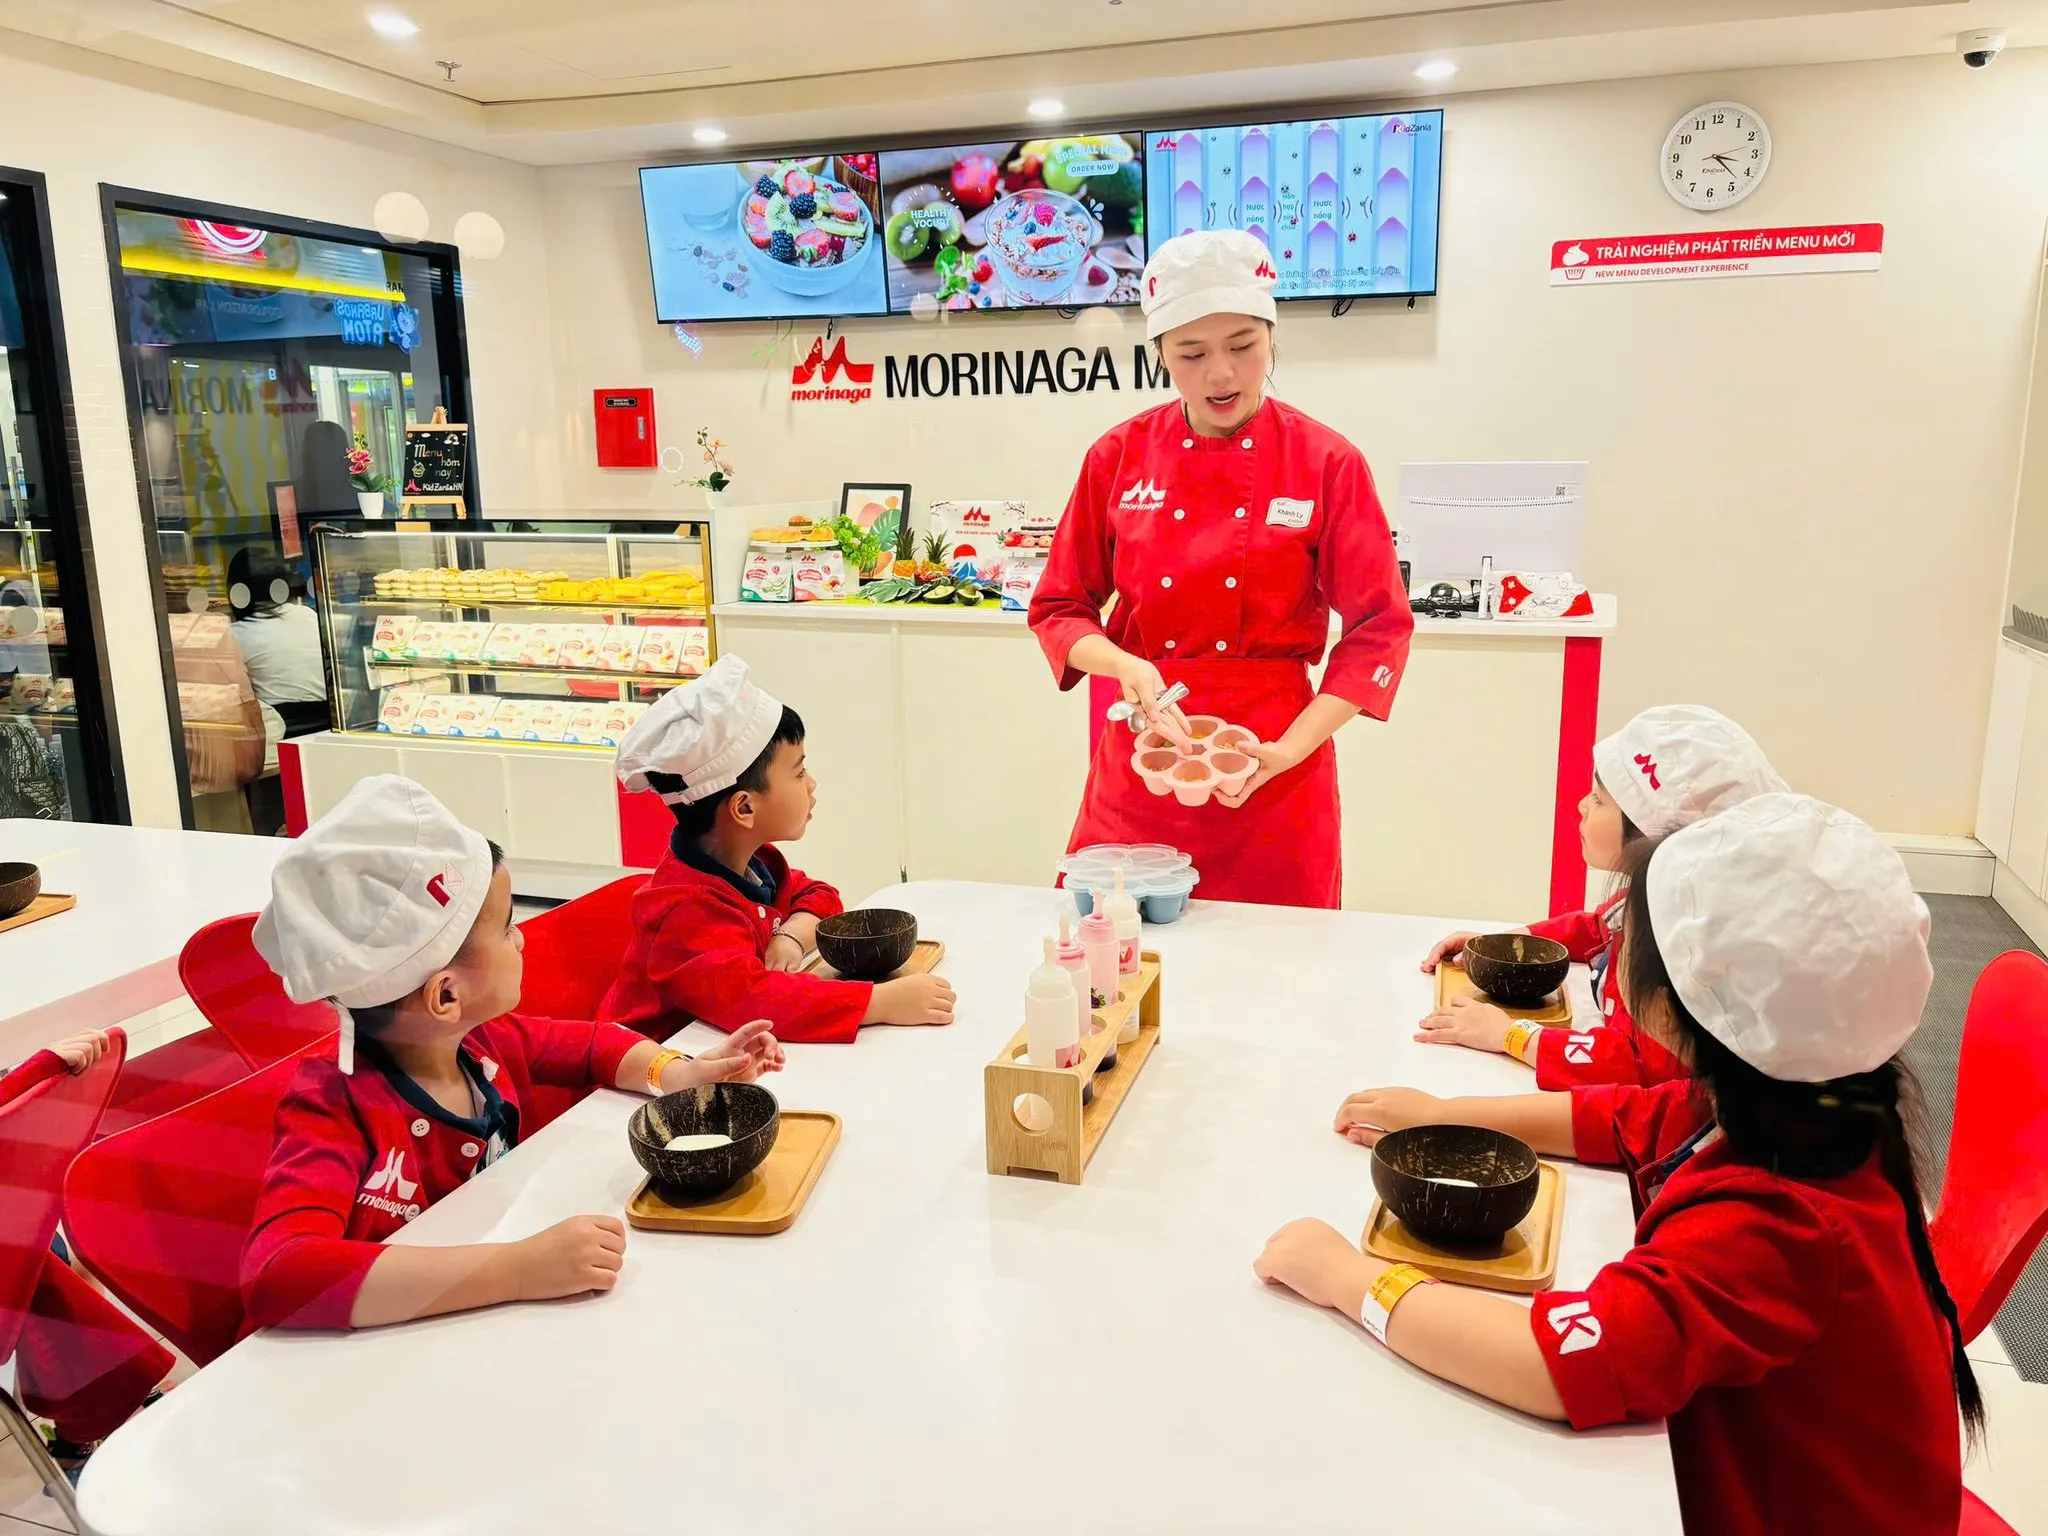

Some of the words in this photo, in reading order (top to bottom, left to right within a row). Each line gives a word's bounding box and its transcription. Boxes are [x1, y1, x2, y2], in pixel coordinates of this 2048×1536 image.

[1711, 114, 1724, 124] 12
[1736, 118, 1741, 128] 1
[1695, 120, 1706, 130] 11
[1680, 134, 1692, 145] 10
[1747, 131, 1755, 141] 2
[1672, 153, 1680, 163] 9
[1751, 149, 1758, 159] 3
[1675, 169, 1683, 180] 8
[1743, 166, 1751, 177] 4
[1689, 182, 1697, 192] 7
[1706, 187, 1714, 198] 6
[1728, 182, 1735, 192] 5
[911, 208, 953, 219] HEALTHY
[914, 218, 951, 228] YOGURT
[1596, 241, 1628, 259] TRẢI
[1630, 240, 1689, 259] NGHIỆM
[1692, 237, 1729, 254] PHÁT
[1732, 233, 1773, 252] TRIỂN
[1776, 235, 1820, 250] MENU
[1823, 231, 1856, 247] MỚI
[1595, 270, 1615, 278] NEW
[1616, 268, 1640, 276] MENU
[1640, 265, 1699, 276] DEVELOPMENT
[1700, 263, 1750, 273] EXPERIENCE
[885, 346, 1120, 398] MORINAGA
[1134, 344, 1172, 389] M
[791, 386, 871, 404] morinaga
[414, 444, 442, 457] Menu
[1117, 501, 1165, 512] morinaga
[356, 1192, 408, 1218] moinaga
